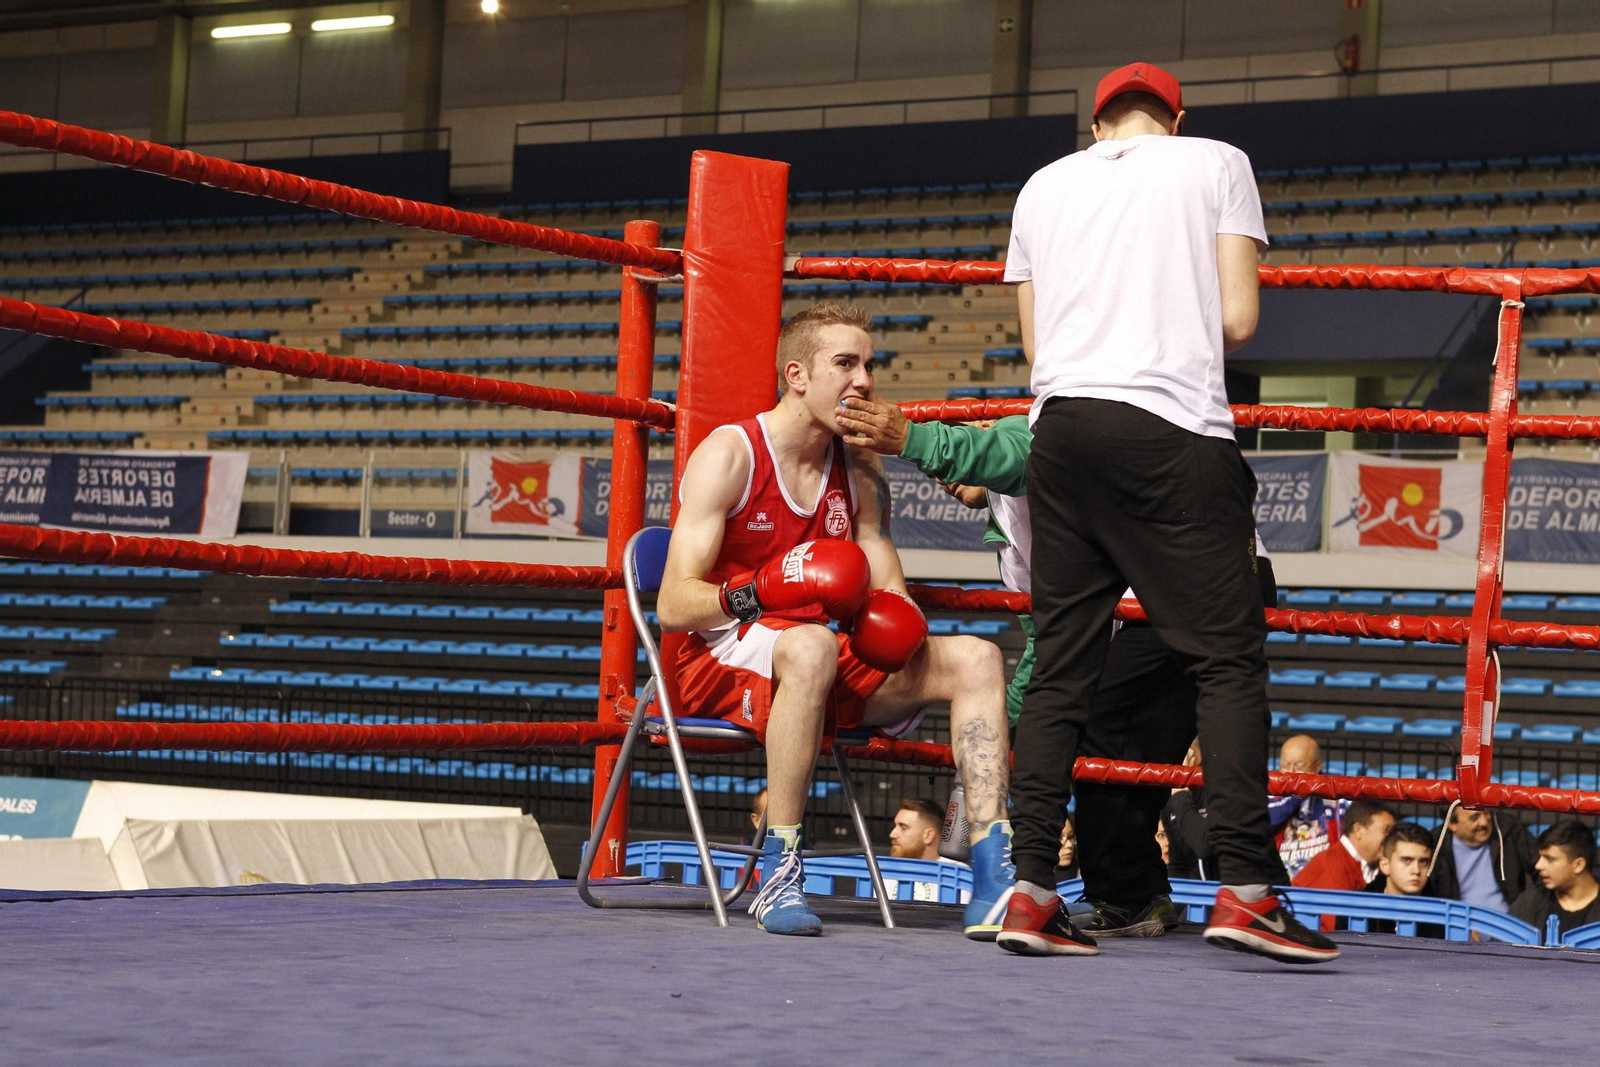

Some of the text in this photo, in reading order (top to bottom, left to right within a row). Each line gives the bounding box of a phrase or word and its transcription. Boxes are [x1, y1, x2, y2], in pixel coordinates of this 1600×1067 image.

[890, 481, 957, 501] EPOR
[900, 501, 989, 520] ALMERIA
[1253, 504, 1308, 522] ERIA
[1507, 510, 1600, 532] DE ALM
